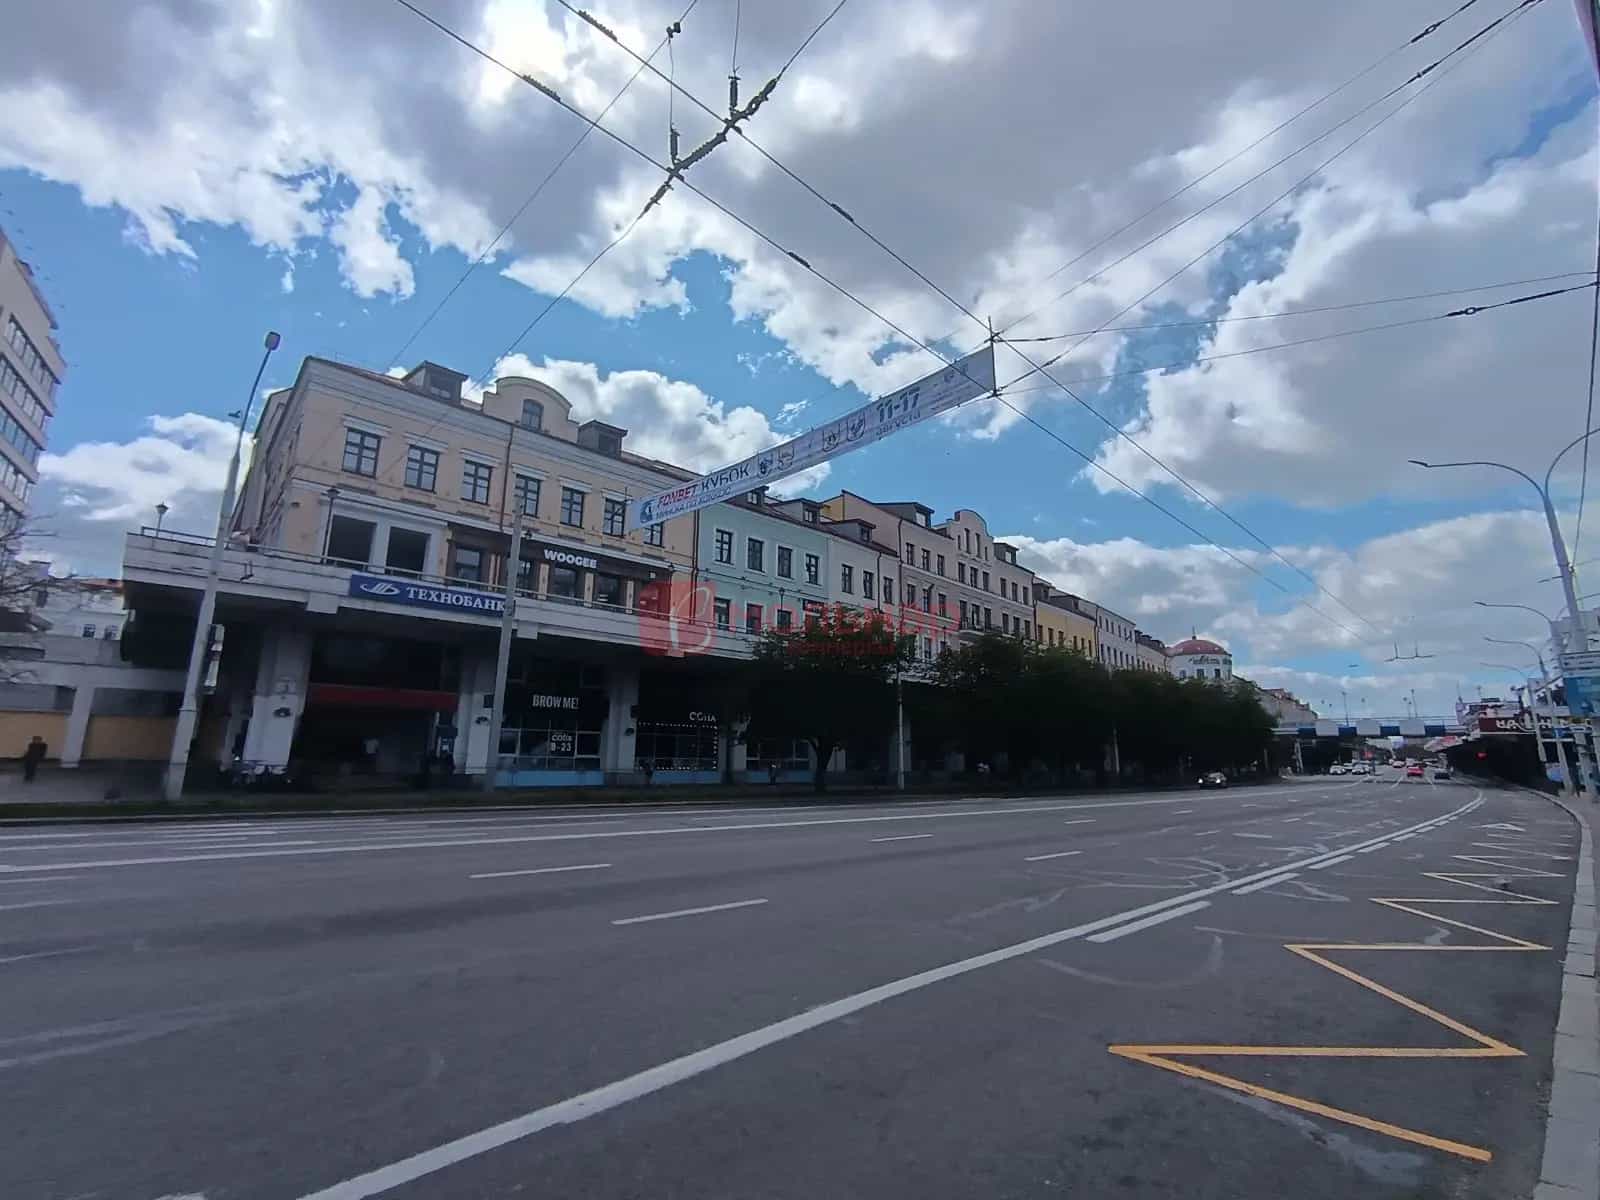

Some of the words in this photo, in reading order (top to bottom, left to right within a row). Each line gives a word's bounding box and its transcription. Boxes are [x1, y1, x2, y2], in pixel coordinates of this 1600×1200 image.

[875, 386, 921, 423] 11-17
[701, 463, 750, 491] КУБОК
[405, 586, 505, 612] ТЕХНОБАНК
[532, 694, 561, 708] BROW
